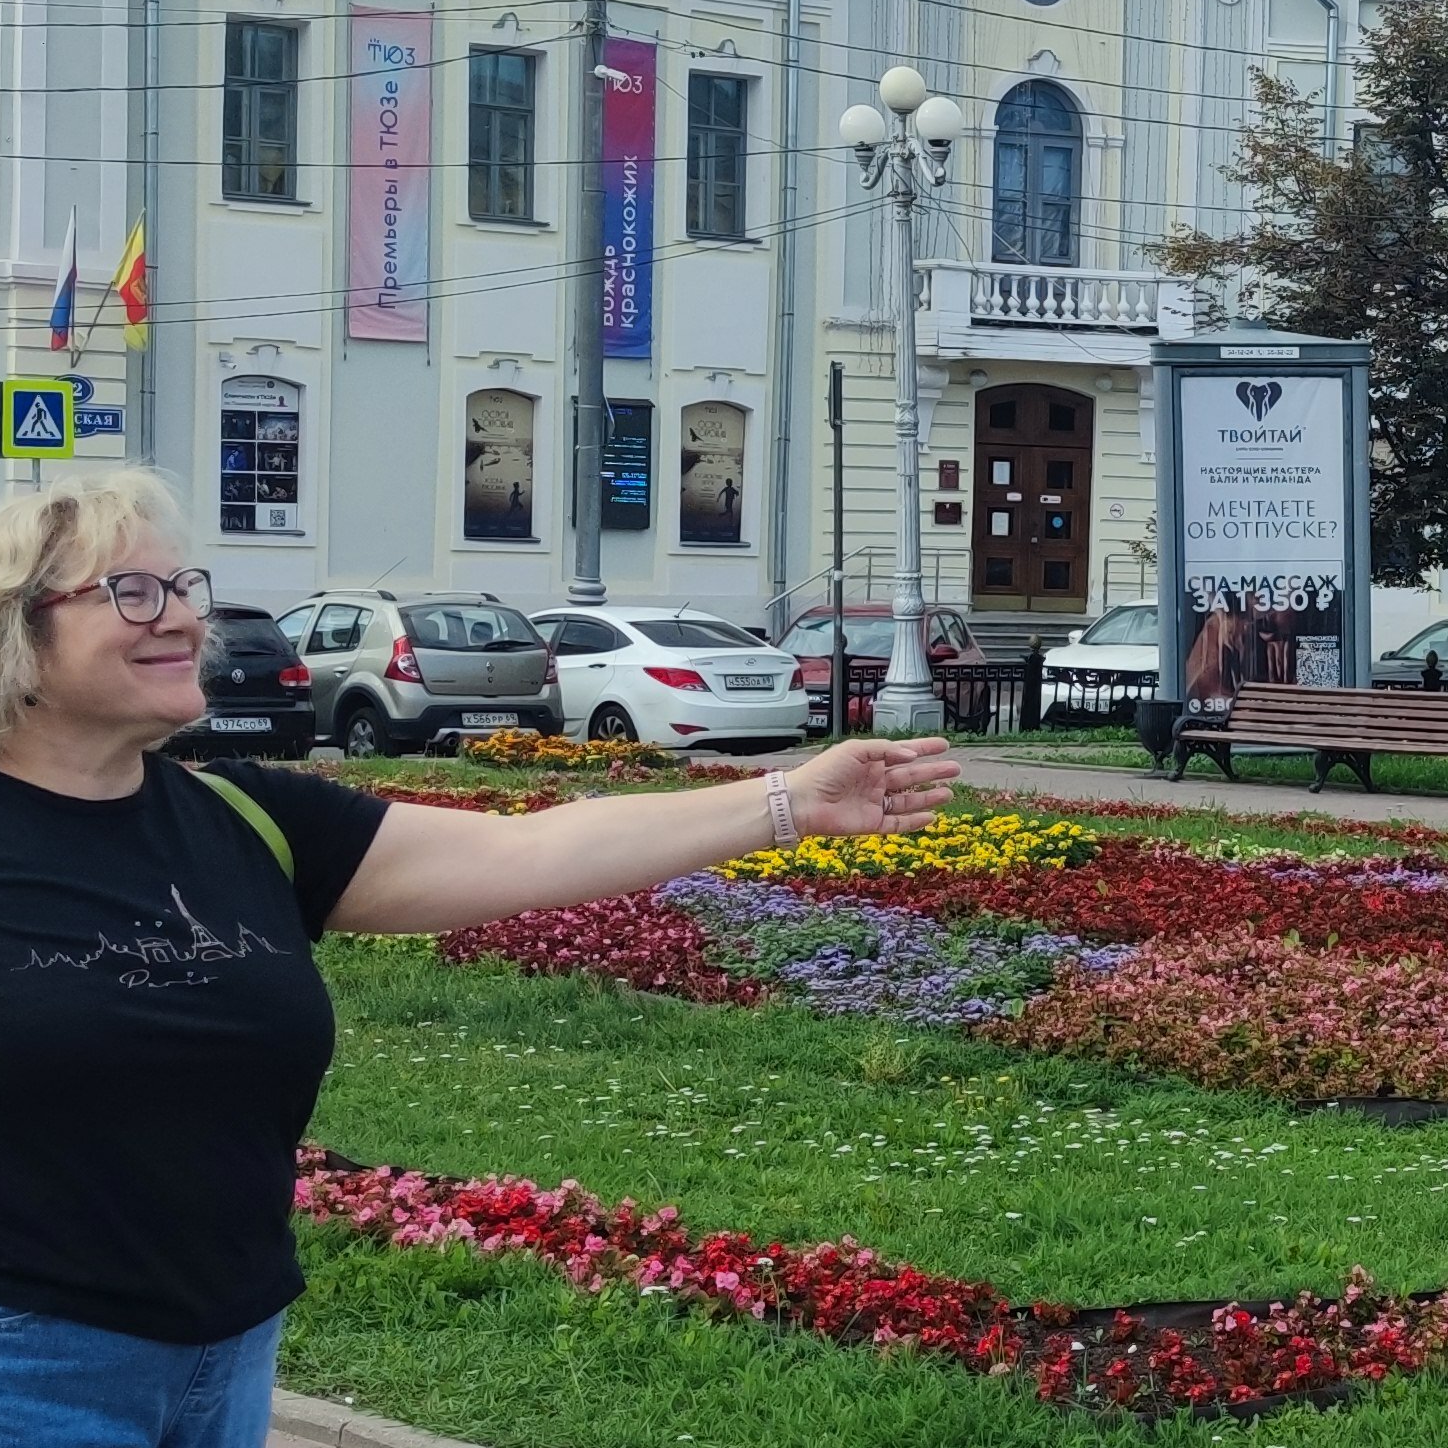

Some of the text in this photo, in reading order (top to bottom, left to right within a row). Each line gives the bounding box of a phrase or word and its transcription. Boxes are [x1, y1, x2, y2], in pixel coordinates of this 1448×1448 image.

[380, 80, 399, 150] ТЮЗе
[378, 179, 402, 310] Премьеры
[74, 413, 113, 426] СКАЯ
[1217, 425, 1302, 444] ТВОЙТАЙ
[1270, 466, 1321, 475] МАСТЕРА
[1207, 500, 1316, 518] МЕЧТАЕТЕ
[1187, 520, 1338, 539] ОБ ОТПУСКЕ?
[1187, 574, 1339, 592] СПА-МАССАЖ
[1191, 590, 1230, 613] ЗА
